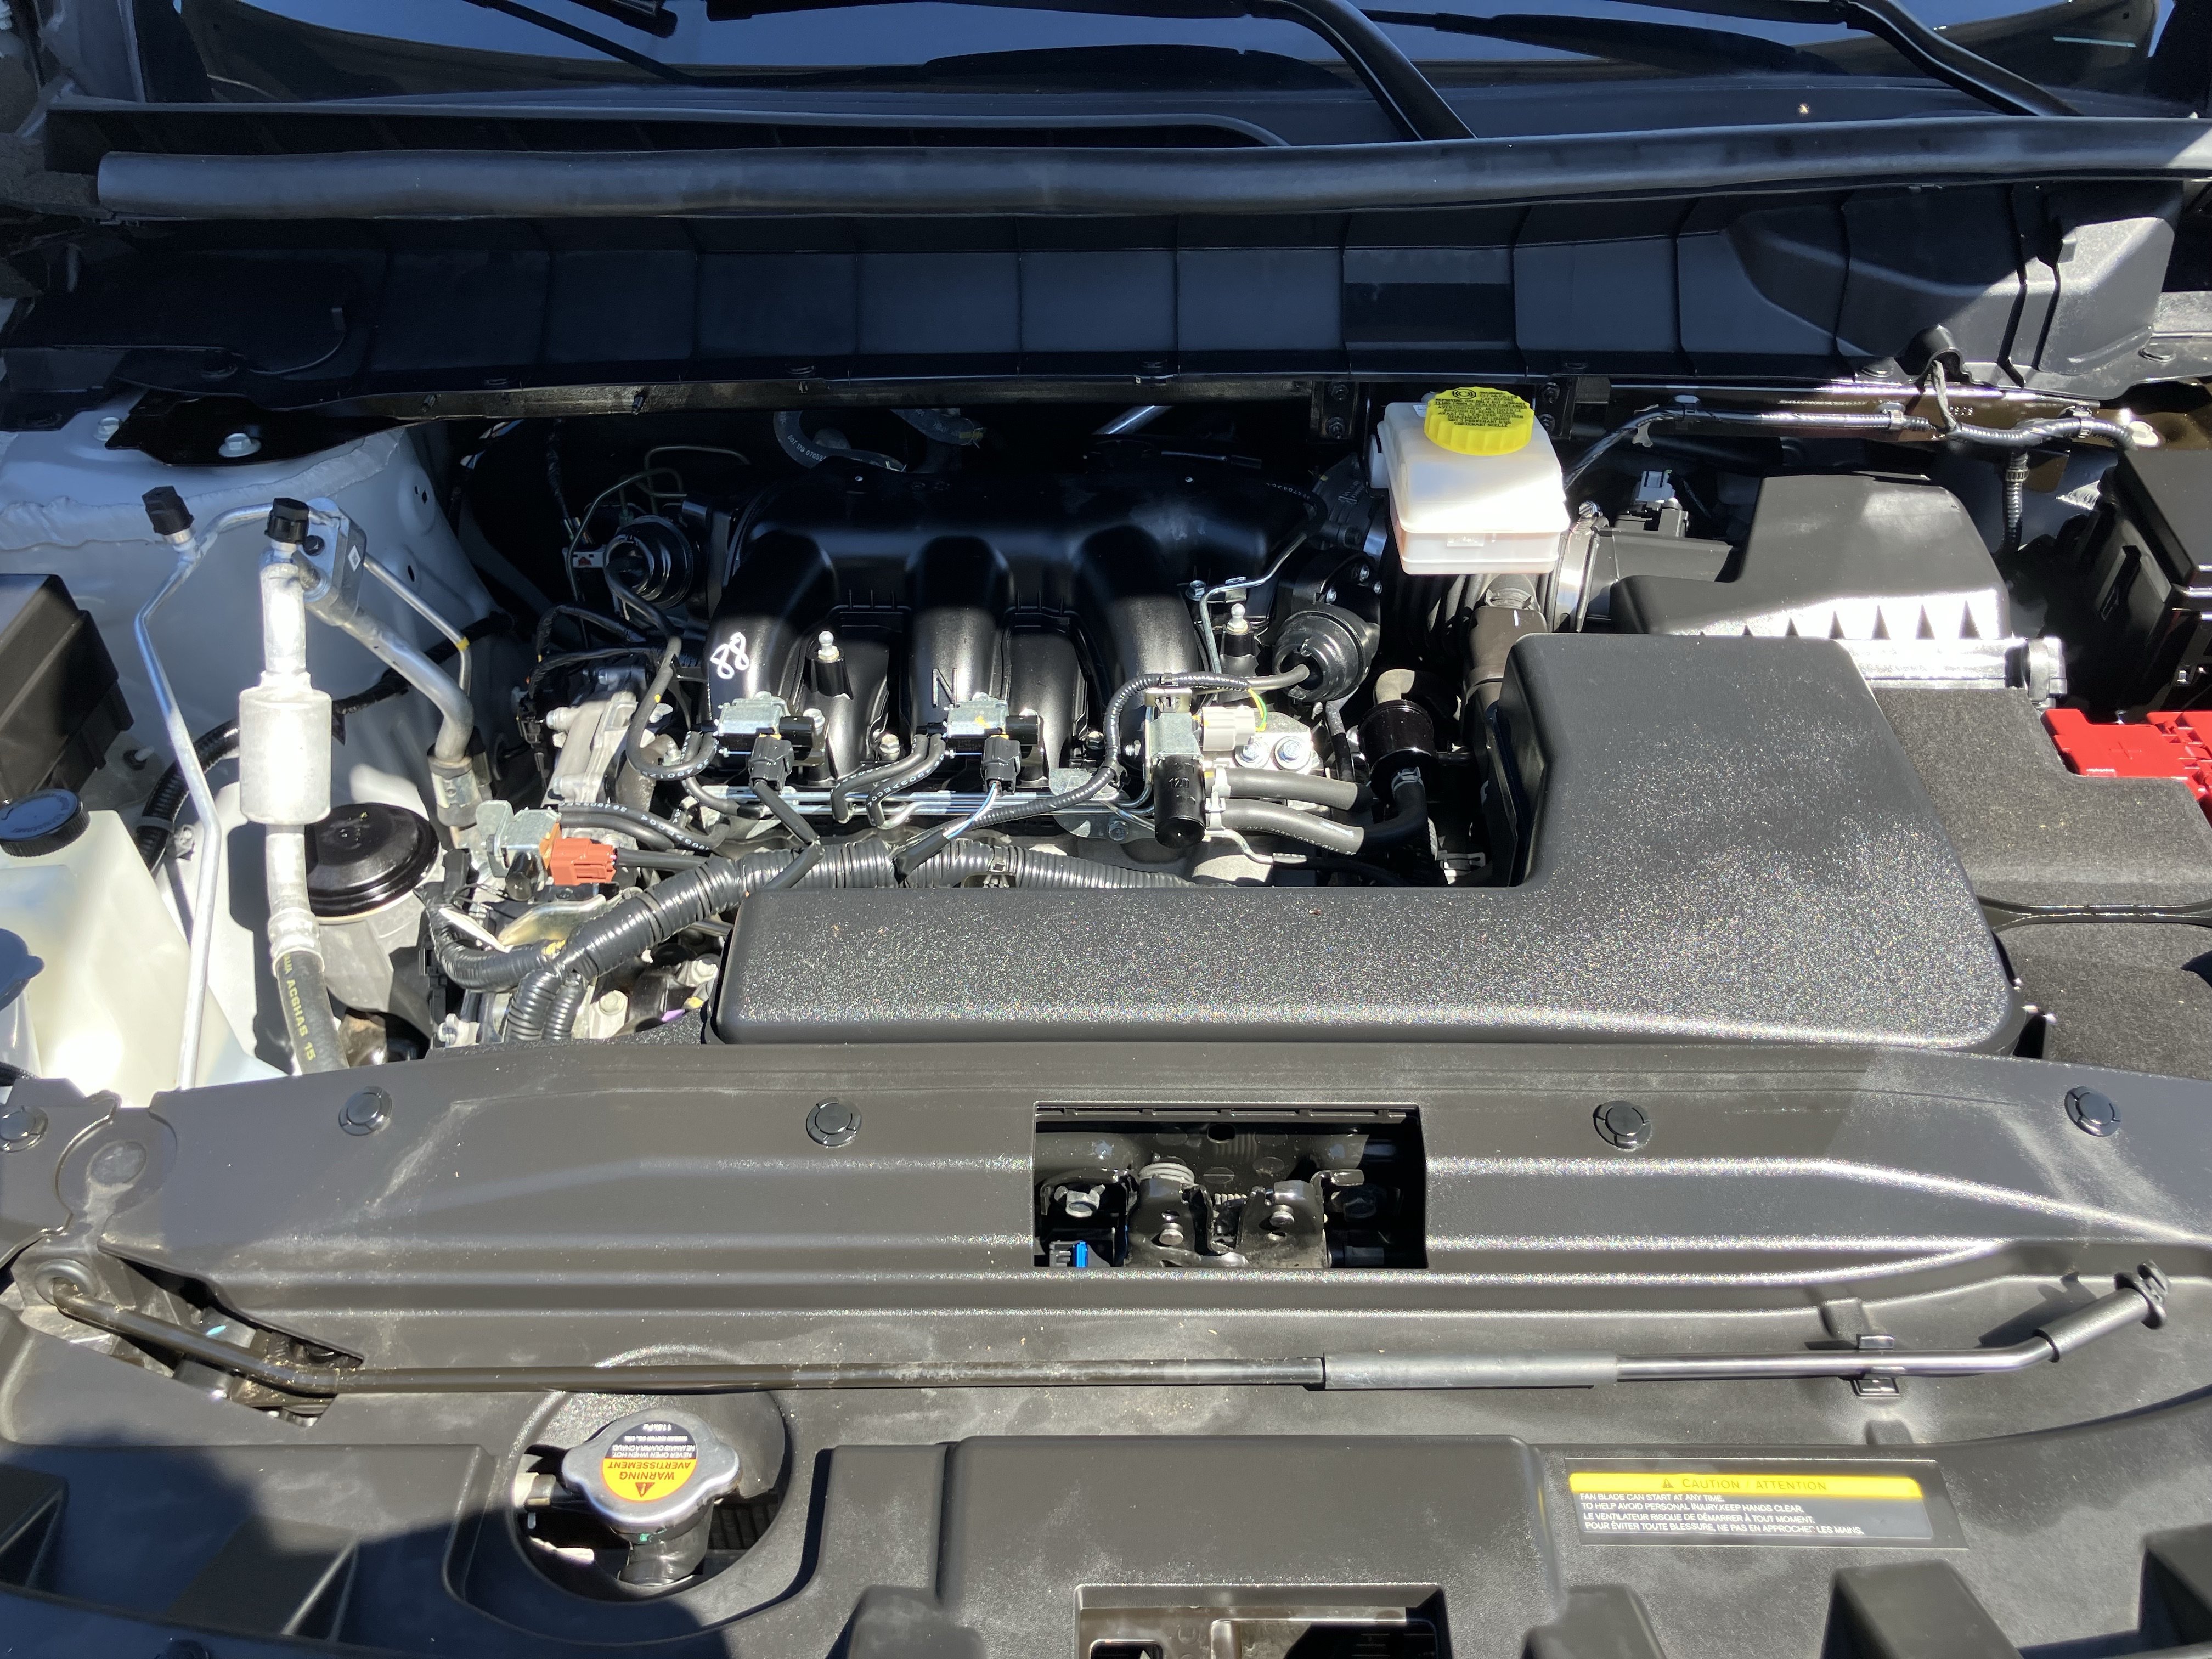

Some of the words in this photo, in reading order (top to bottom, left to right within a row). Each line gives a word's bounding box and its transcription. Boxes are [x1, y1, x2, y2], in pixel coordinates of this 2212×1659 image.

[304, 1042, 317, 1061] 15
[619, 1471, 674, 1480] WARNING
[1682, 1479, 1740, 1489] CAUTION
[1756, 1480, 1827, 1491] ATTENTION
[1742, 1504, 1775, 1513] HANDS
[1650, 1513, 1683, 1521] RISQUE
[1696, 1512, 1743, 1522] DÉMARRER
[1745, 1513, 1751, 1522] À
[1775, 1515, 1815, 1523] MOMENT.
[1611, 1520, 1640, 1530] ÉVITER
[1640, 1522, 1667, 1531] TOUTE
[1669, 1522, 1716, 1532] BLESSURE,
[1817, 1525, 1833, 1534] LES
[1834, 1526, 1865, 1534] MAINS.
